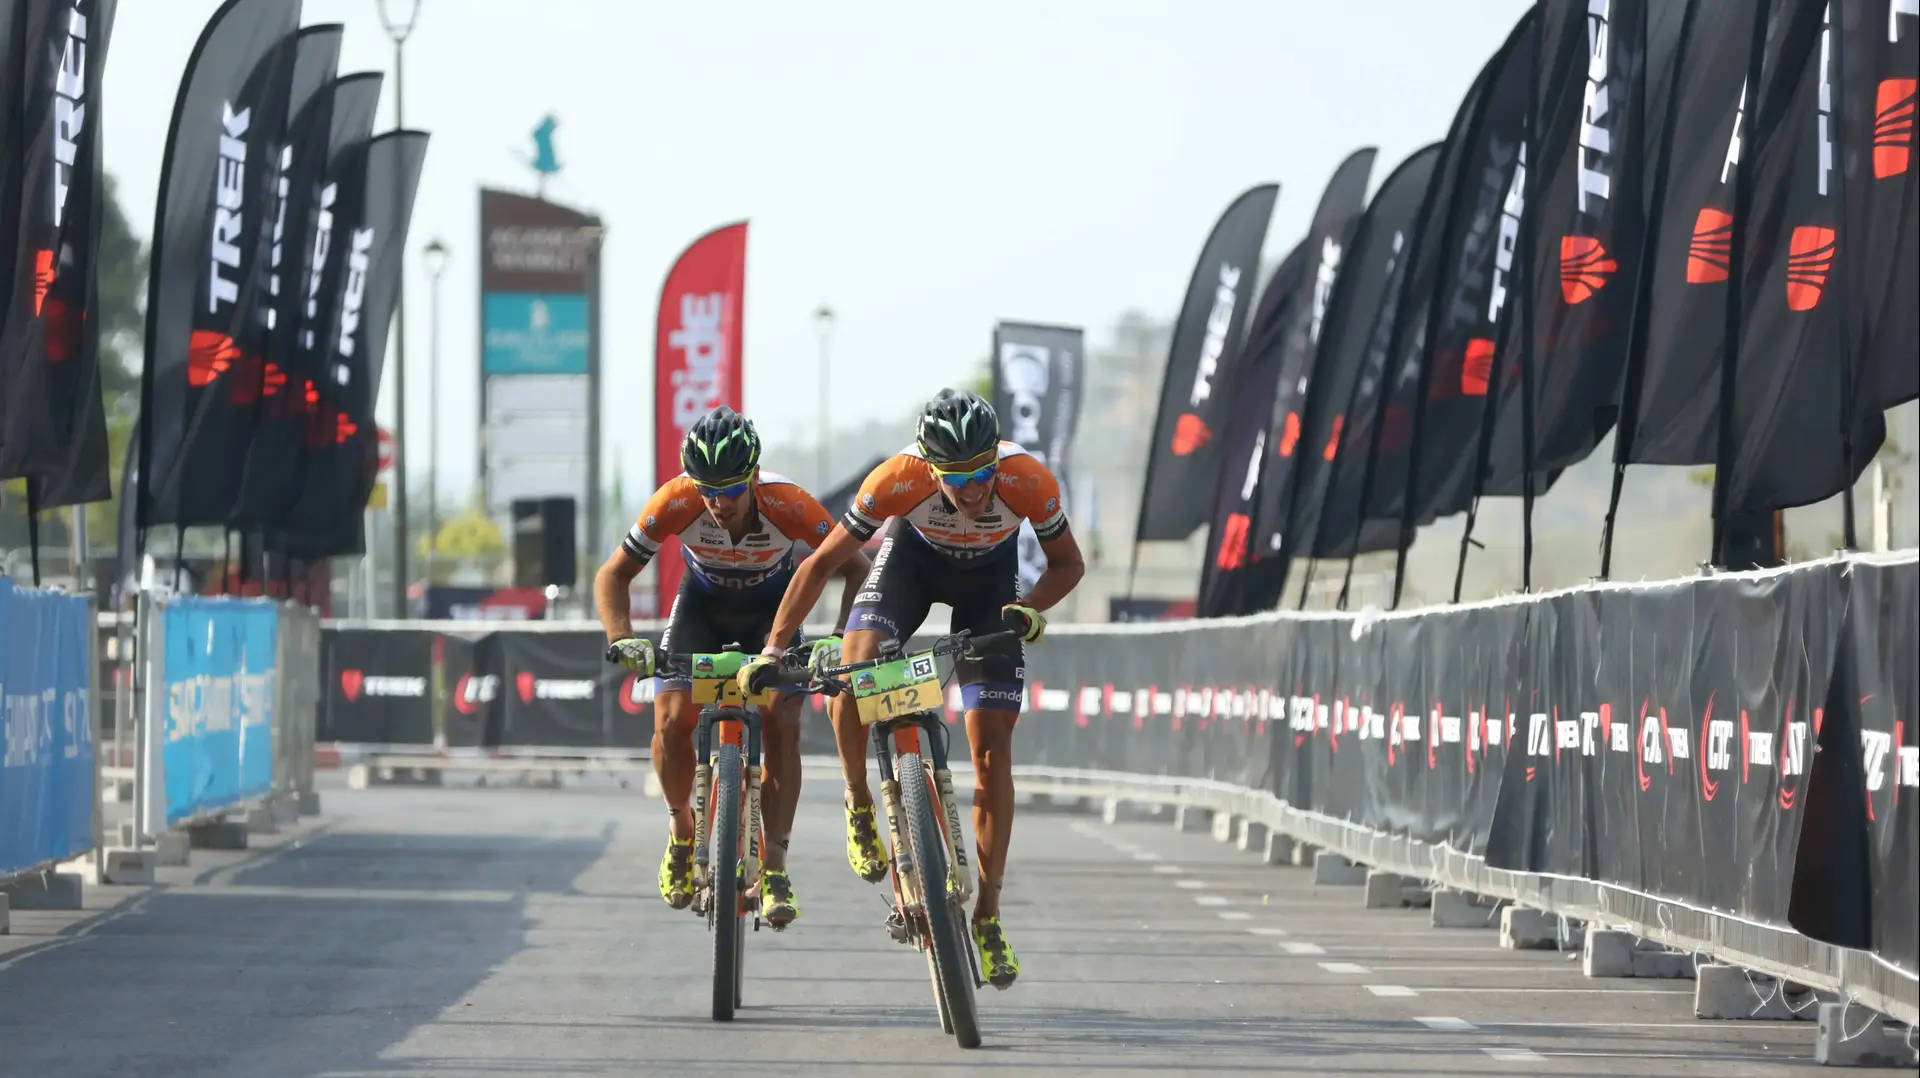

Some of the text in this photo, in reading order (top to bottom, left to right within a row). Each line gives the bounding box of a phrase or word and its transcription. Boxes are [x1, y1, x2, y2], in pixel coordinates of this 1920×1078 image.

[210, 99, 250, 314] TREK
[1189, 261, 1241, 407] TREK
[880, 687, 921, 714] 1-2
[1708, 719, 1734, 770] CTC
[750, 798, 761, 834] SWISS
[945, 803, 963, 841] SWISS
